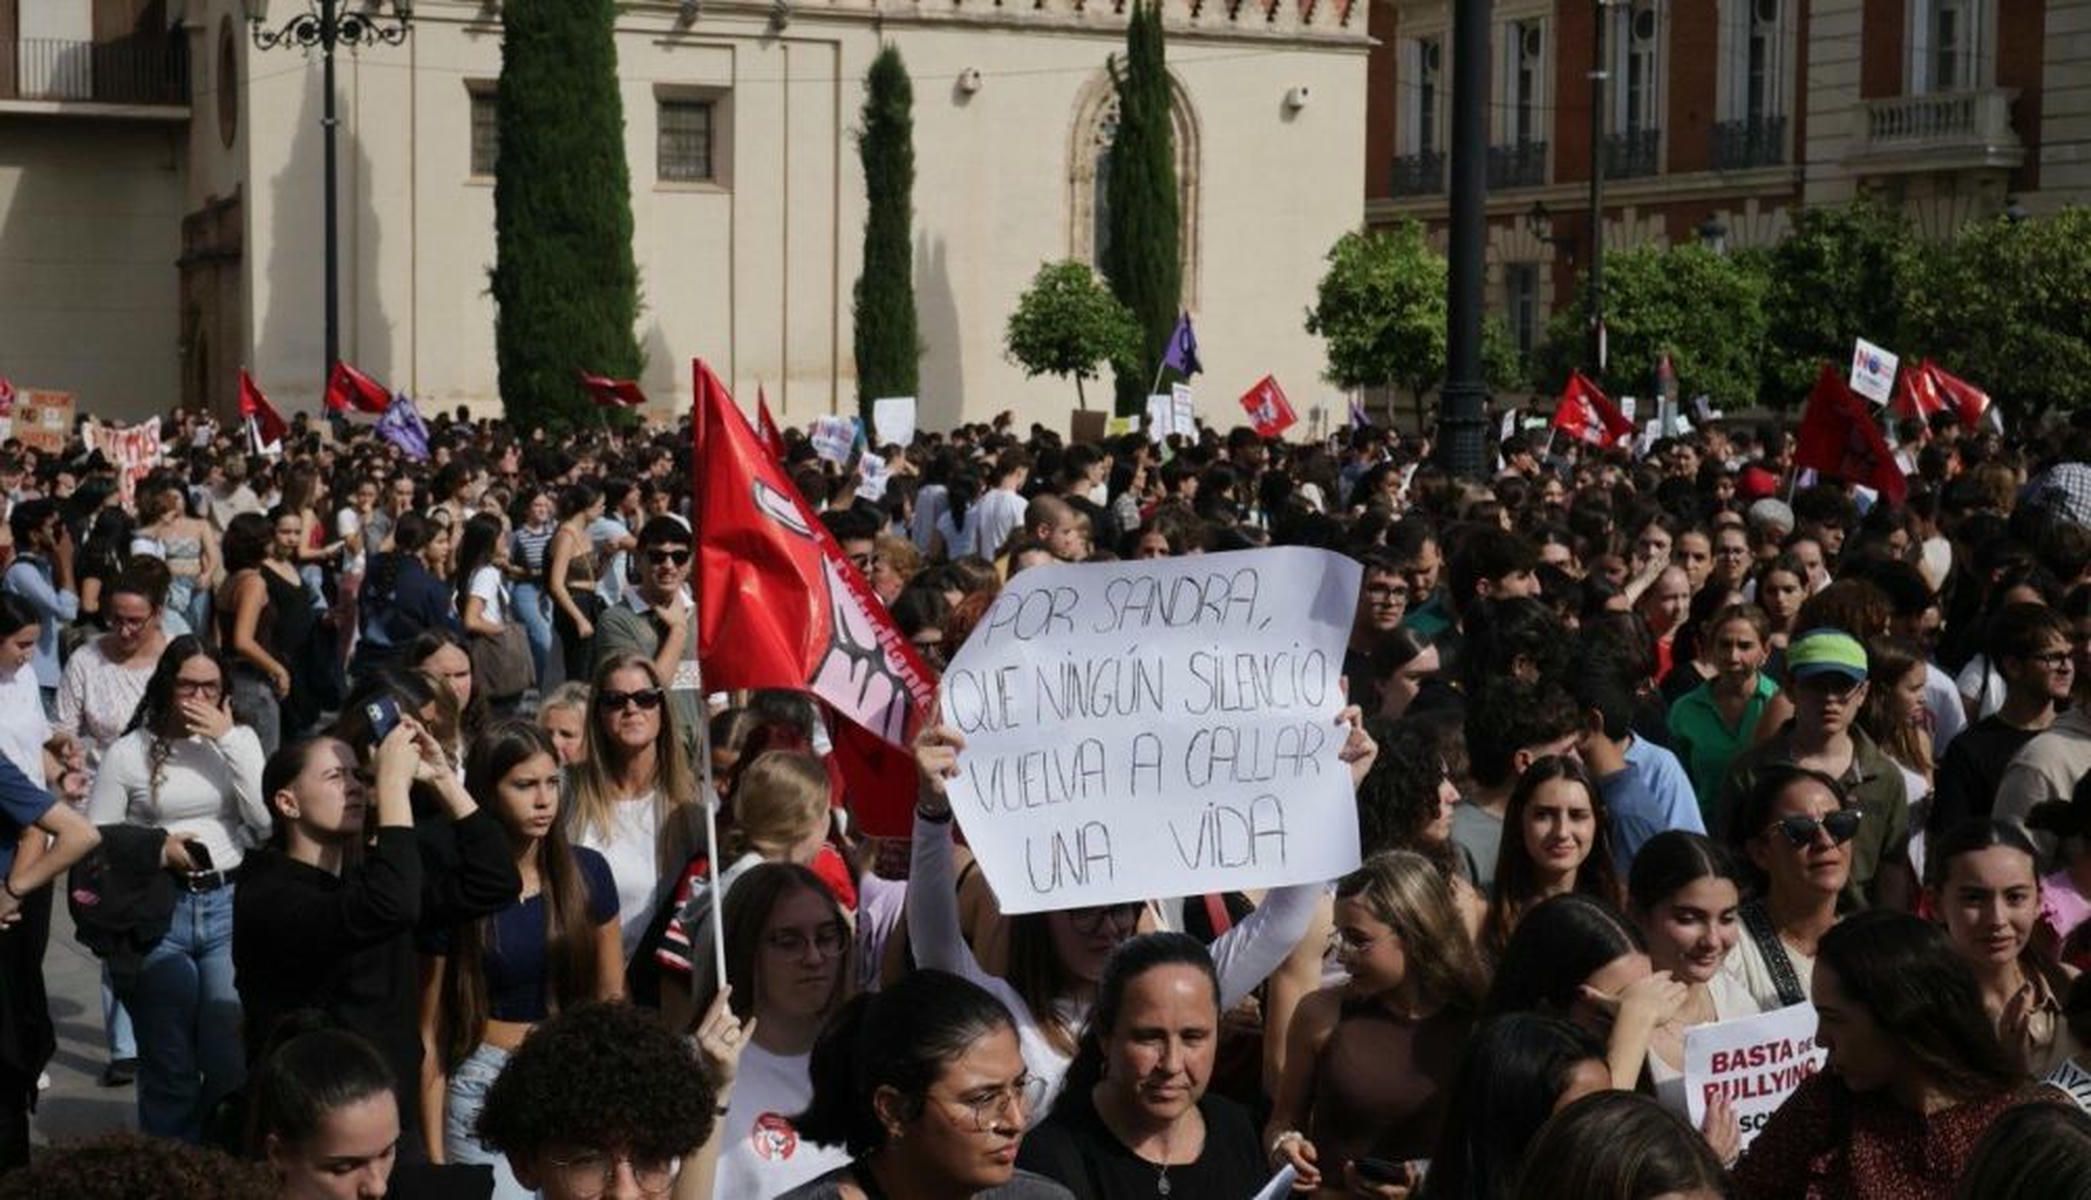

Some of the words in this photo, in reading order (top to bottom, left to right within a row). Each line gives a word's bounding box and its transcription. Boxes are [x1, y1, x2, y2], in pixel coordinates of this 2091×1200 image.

[985, 586, 1079, 645] POR
[1093, 568, 1272, 634] SANDRA,
[949, 666, 1019, 736] QUE
[969, 738, 1107, 814] VUELVA
[1130, 732, 1163, 797] A
[1185, 721, 1325, 789] CALLAR
[1025, 820, 1114, 893] UNA
[1168, 793, 1287, 870] VIDA
[1711, 1038, 1793, 1075] BASTA
[1798, 1037, 1813, 1055] DE
